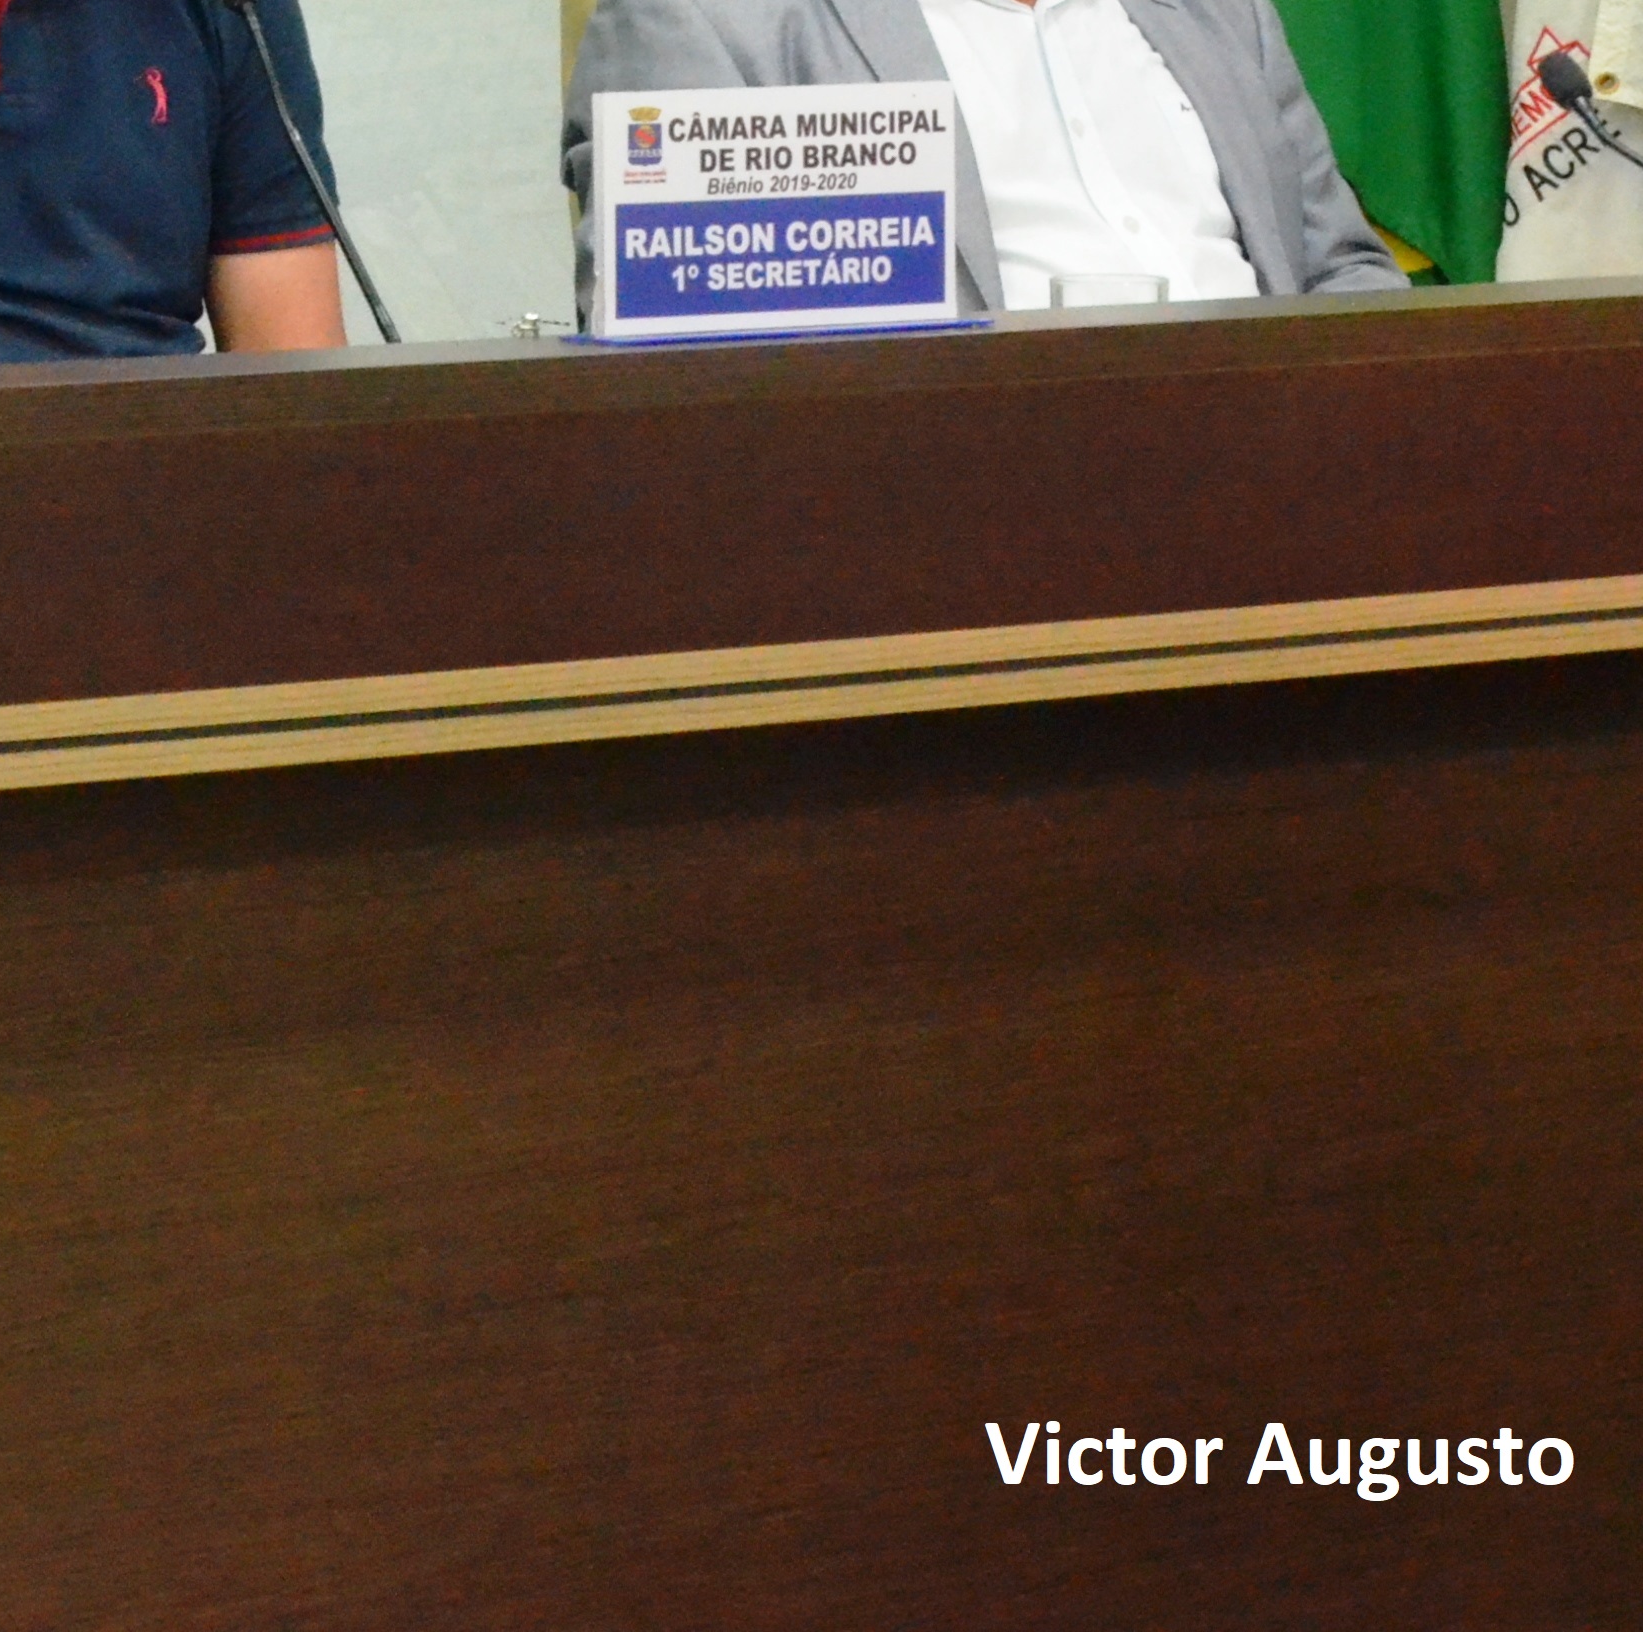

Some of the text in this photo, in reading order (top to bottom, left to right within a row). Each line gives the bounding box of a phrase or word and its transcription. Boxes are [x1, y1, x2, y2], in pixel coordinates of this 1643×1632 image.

[668, 109, 946, 143] CÂMARA MUNICIPAL
[700, 141, 916, 173] DE RIO BRANCO
[707, 173, 857, 196] Biênio 2019-2020
[626, 216, 935, 260] RAILSON CORREIA
[708, 252, 892, 291] SECRETÁRIO
